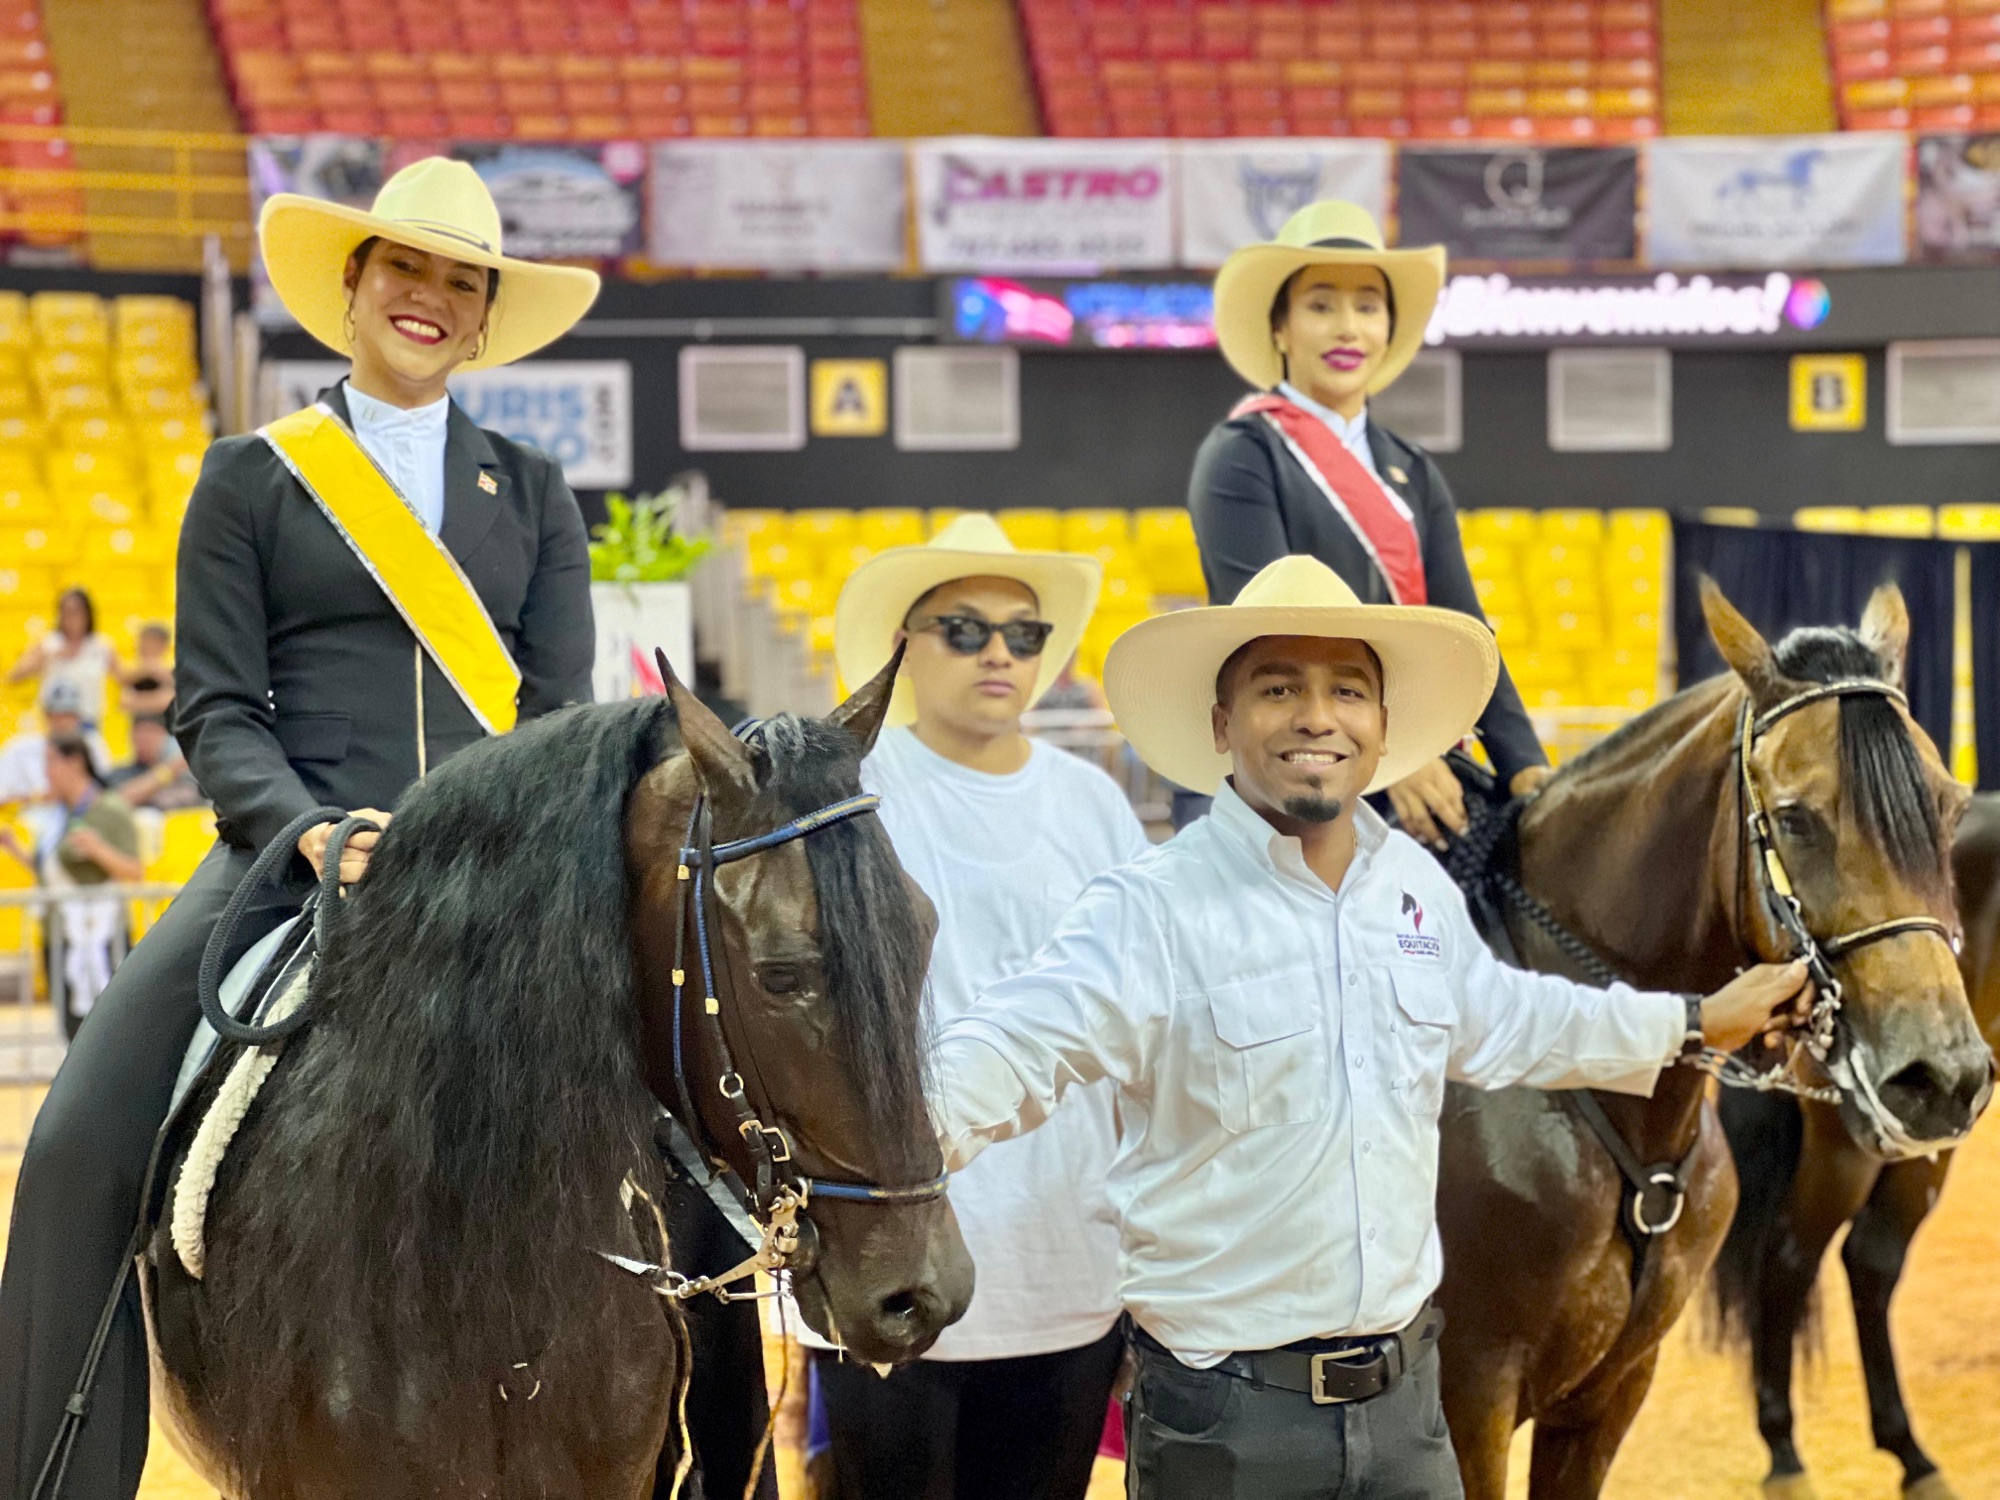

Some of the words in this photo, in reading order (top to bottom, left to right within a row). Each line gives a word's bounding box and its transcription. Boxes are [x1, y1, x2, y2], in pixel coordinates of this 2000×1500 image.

[945, 165, 1163, 202] CASTRO
[831, 377, 867, 416] A
[1812, 373, 1844, 411] B
